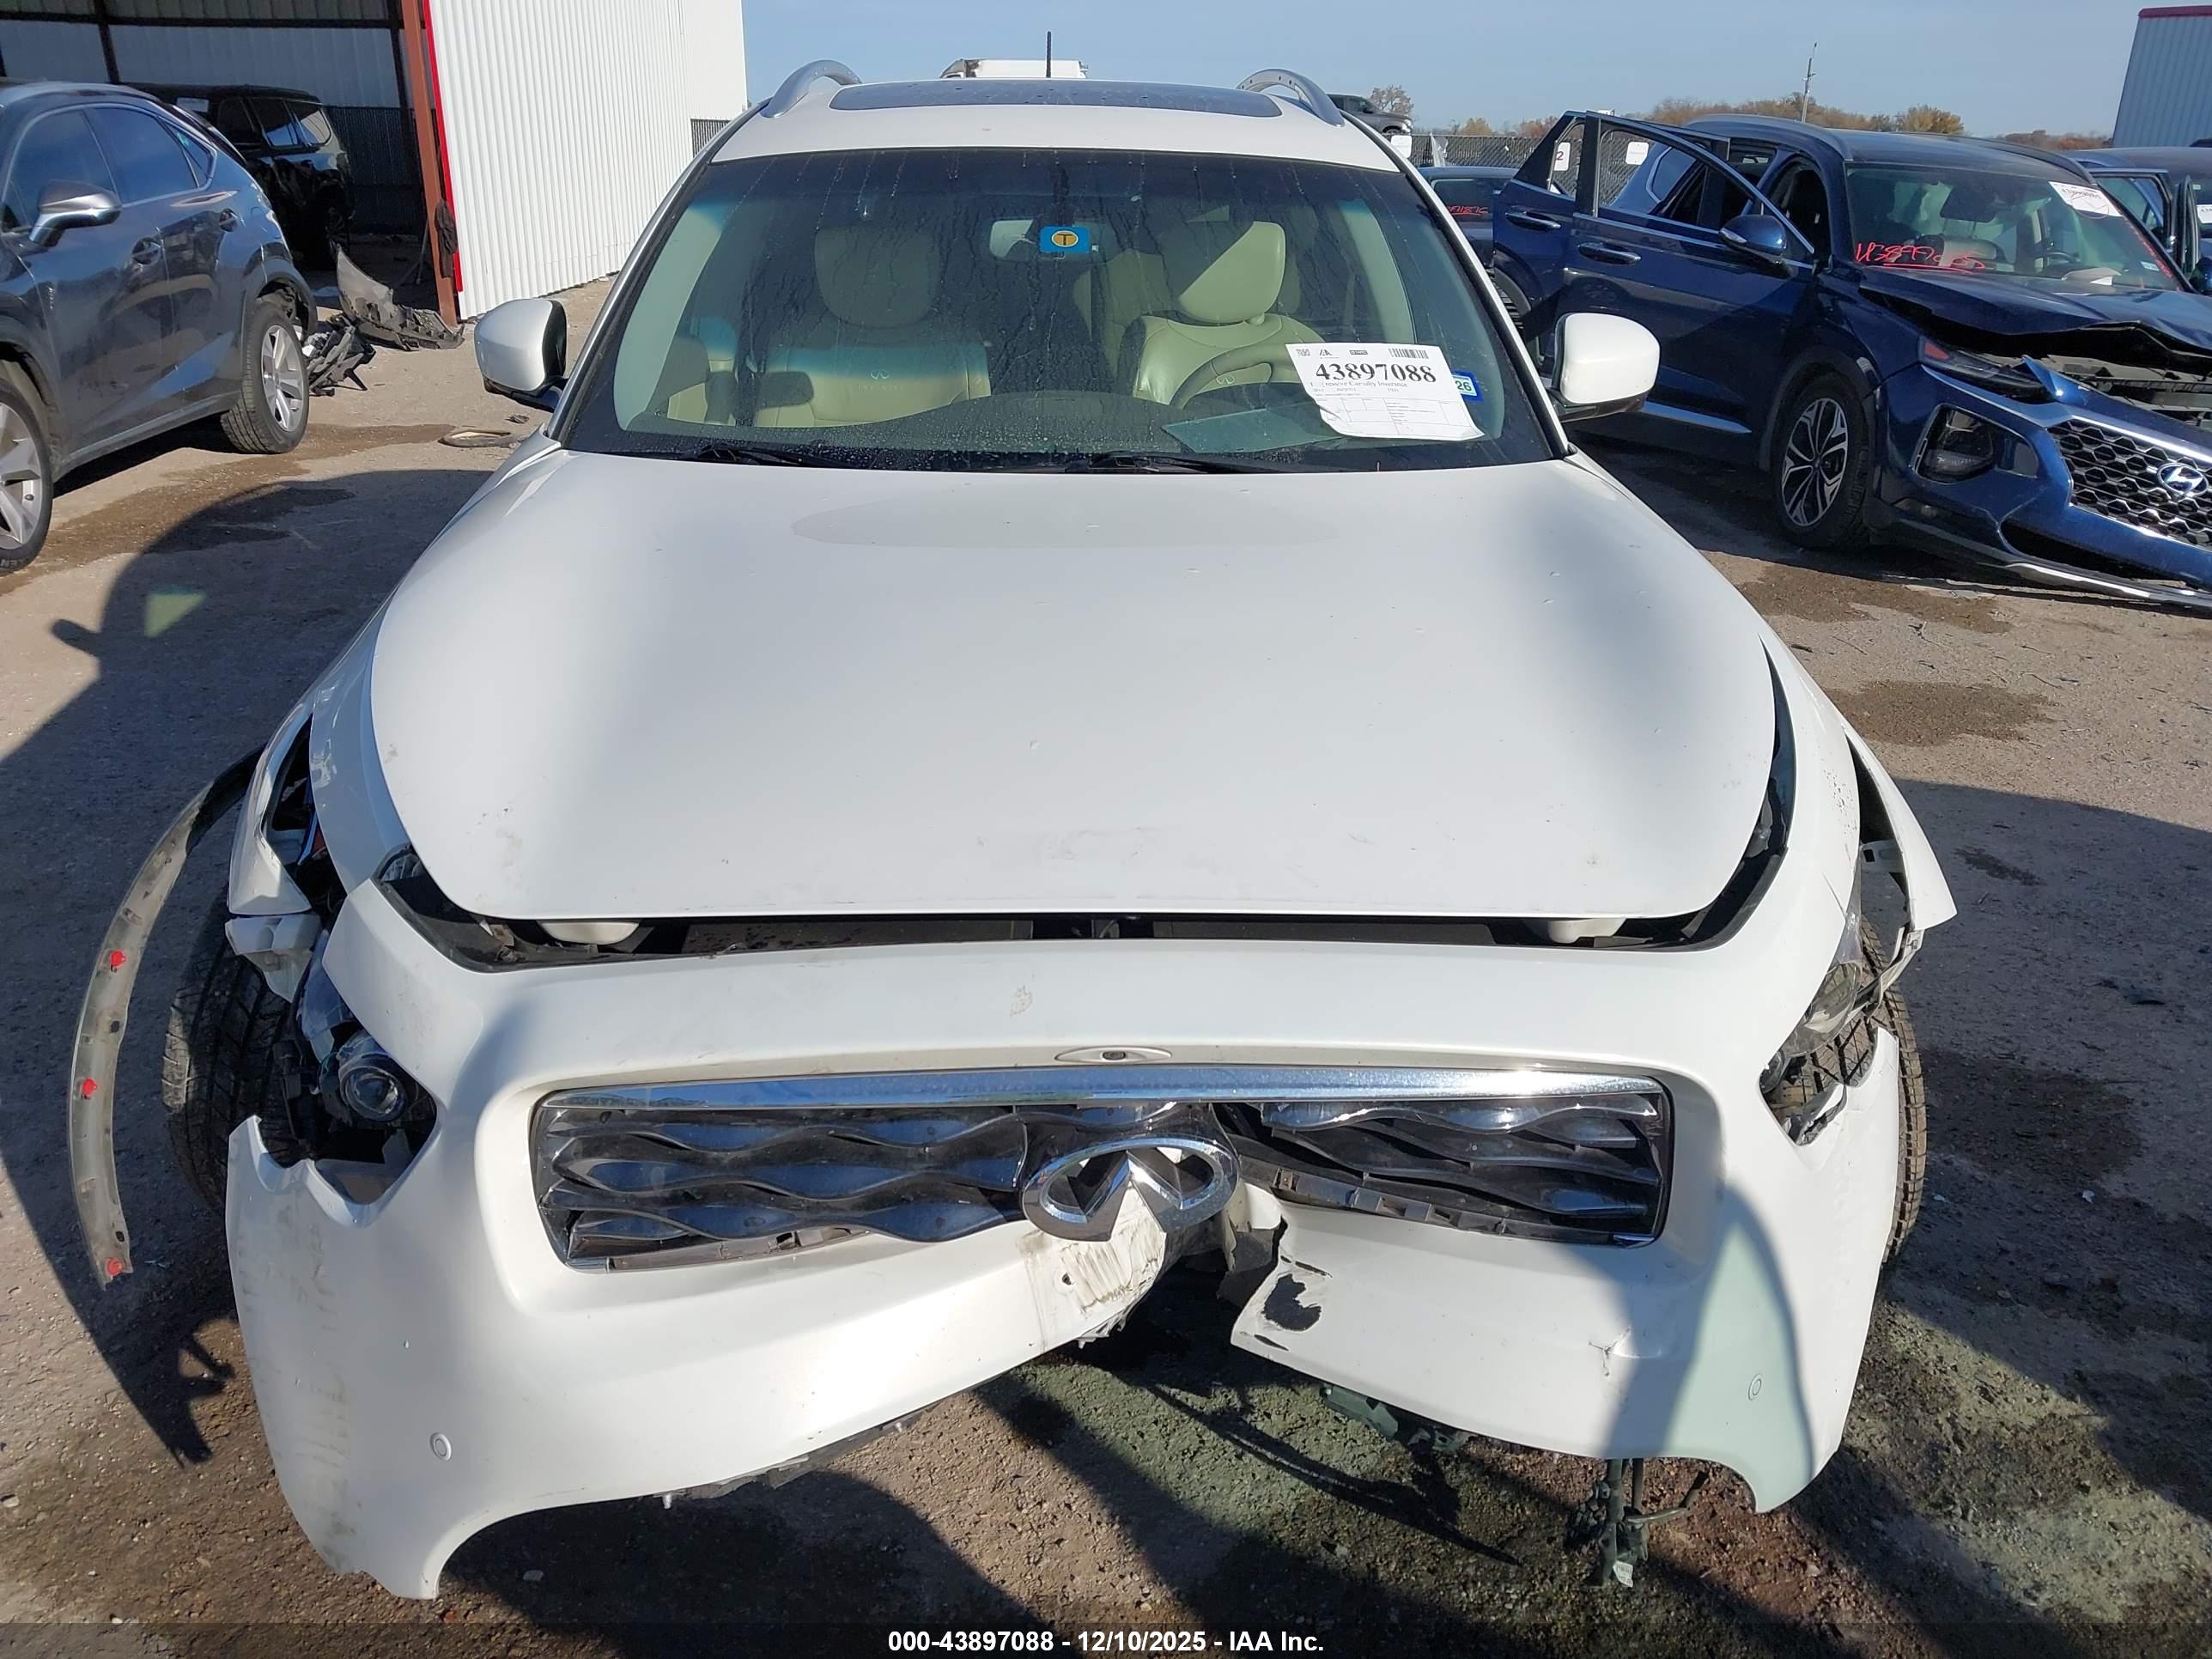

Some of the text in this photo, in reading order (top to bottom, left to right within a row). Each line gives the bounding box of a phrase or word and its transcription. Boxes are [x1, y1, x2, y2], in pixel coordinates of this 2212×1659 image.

[1057, 233, 1073, 246] T
[1316, 363, 1437, 383] 43897088
[1455, 380, 1473, 392] 26
